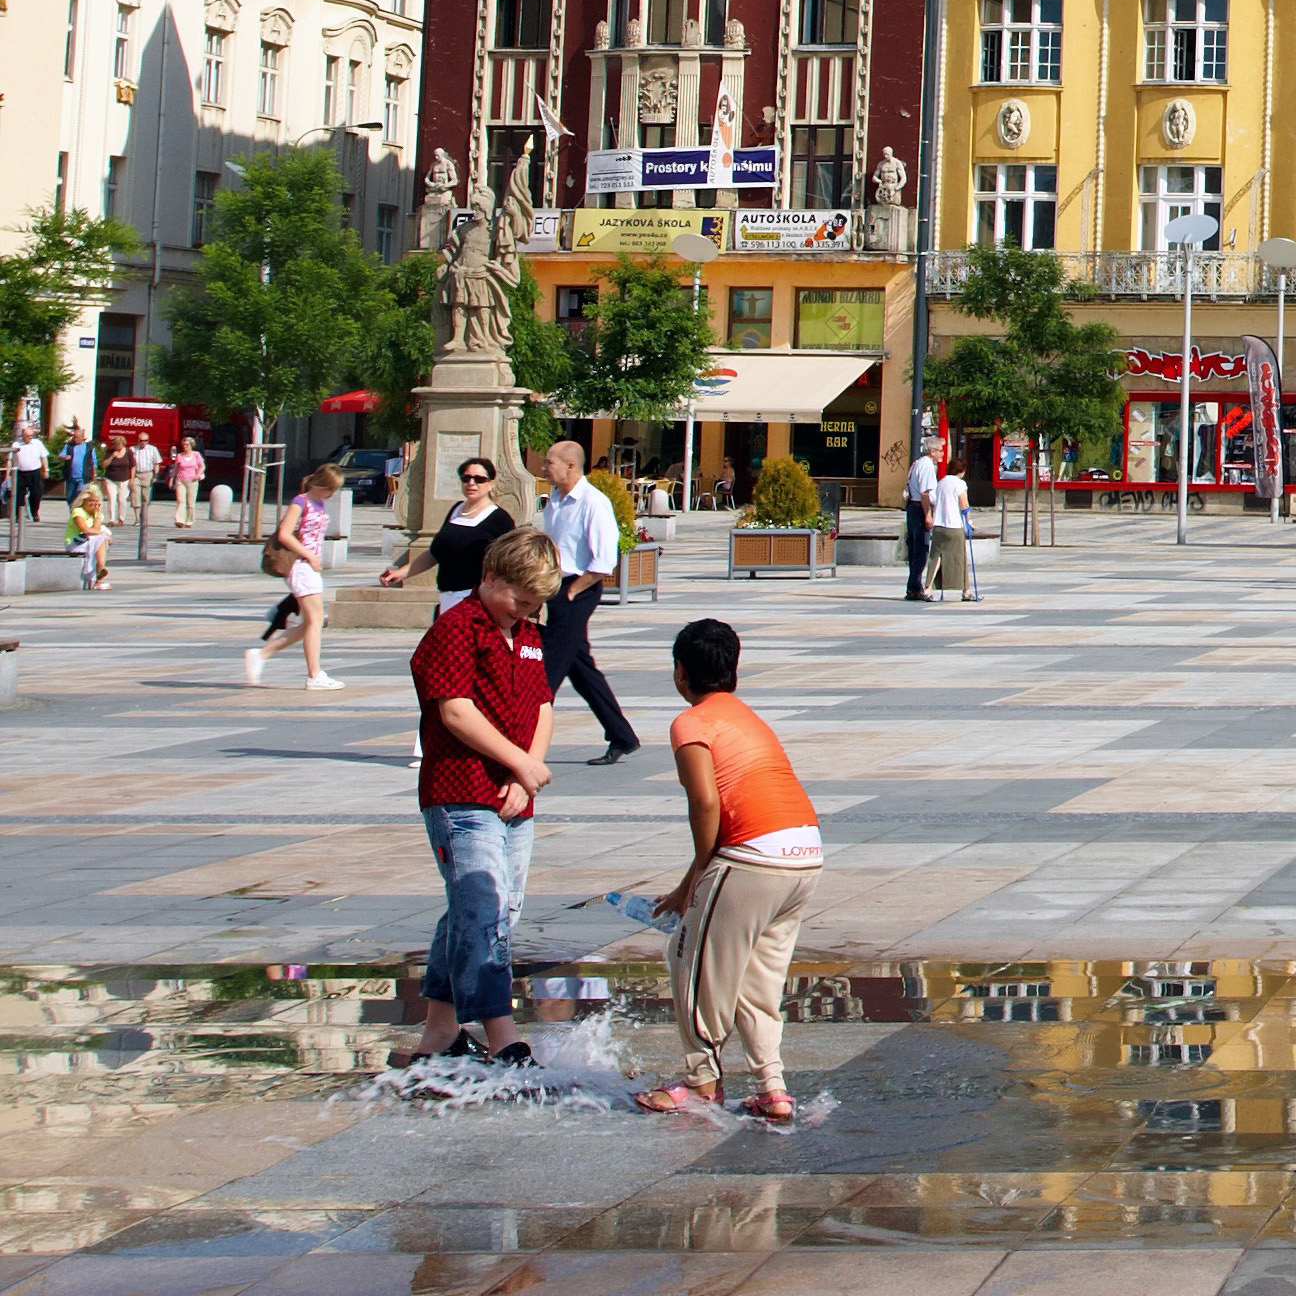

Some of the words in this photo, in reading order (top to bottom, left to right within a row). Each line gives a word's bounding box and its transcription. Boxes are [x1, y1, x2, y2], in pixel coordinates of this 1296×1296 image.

[645, 161, 697, 175] Prostory
[733, 160, 773, 174] nájmu
[657, 216, 691, 228] ŠKOLA
[741, 212, 816, 224] AUTOŠKOLA
[533, 217, 559, 234] ECT
[820, 421, 855, 433] HERNA
[826, 436, 848, 448] BAR
